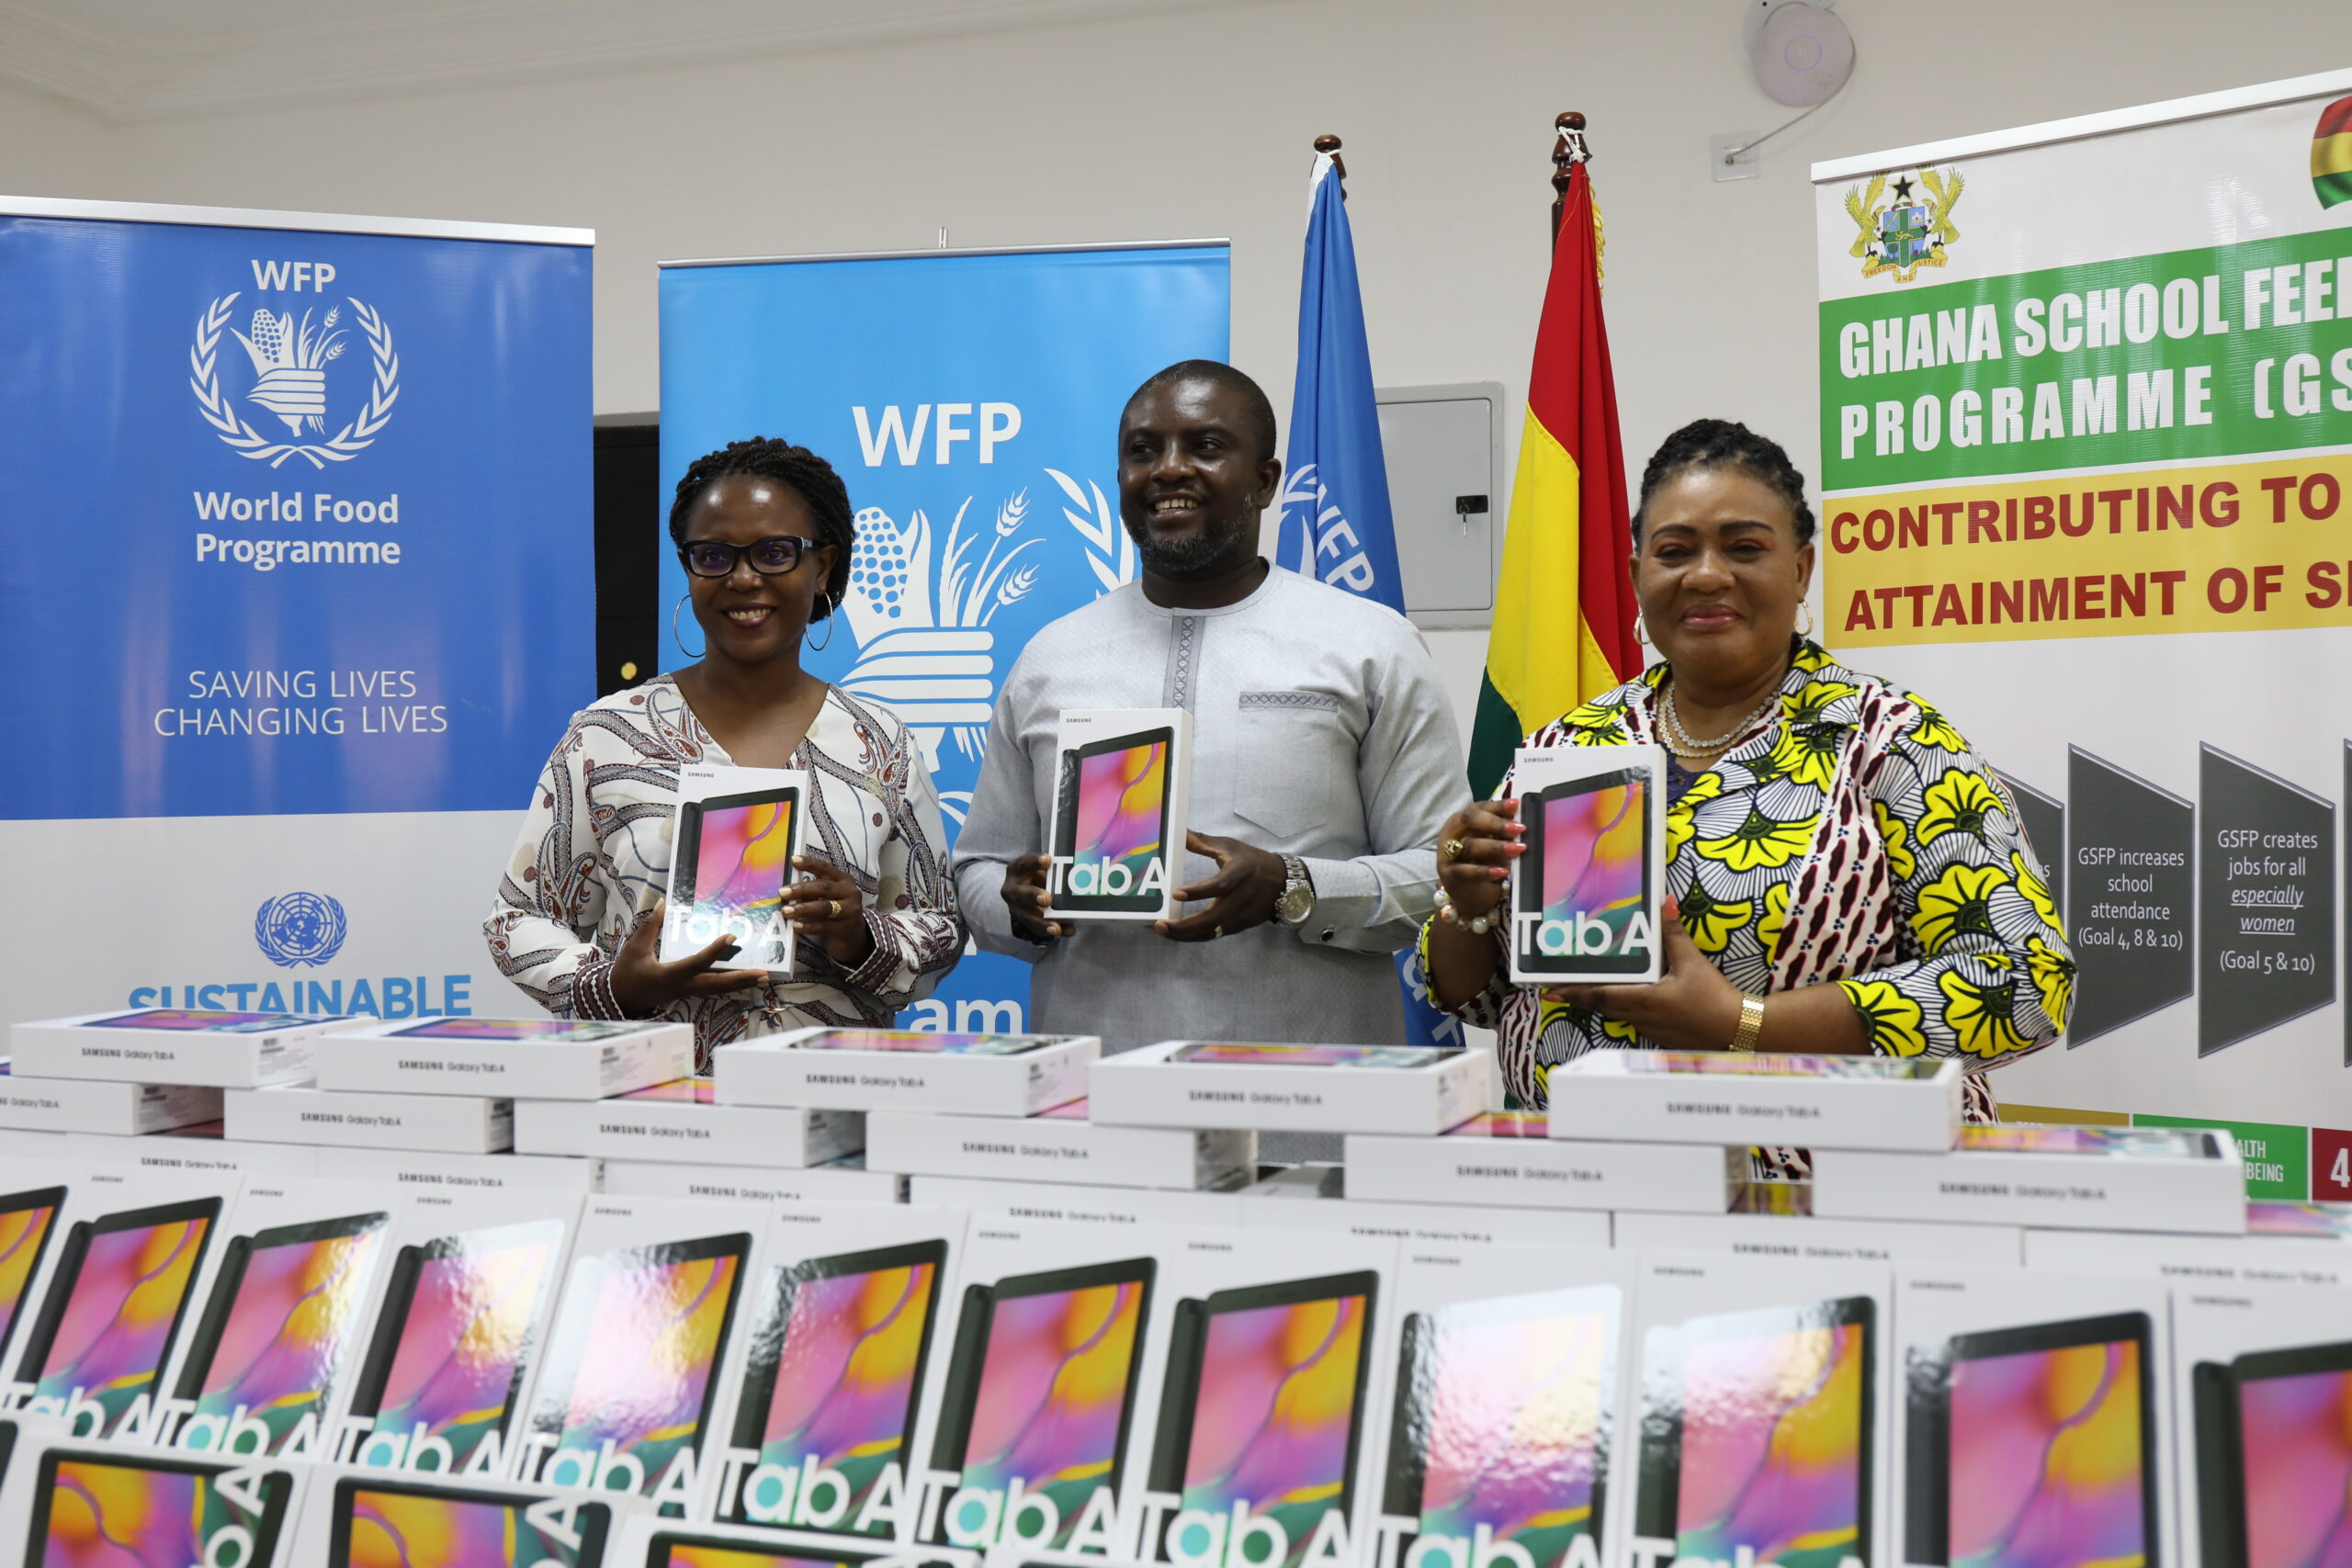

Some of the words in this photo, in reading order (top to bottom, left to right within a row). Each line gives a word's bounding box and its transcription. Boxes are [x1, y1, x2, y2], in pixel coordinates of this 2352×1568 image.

[252, 259, 336, 292] WFP
[1866, 265, 1896, 276] FREEDOM
[1839, 303, 2002, 378] GHANA
[2014, 275, 2228, 357] SCHOOL
[1841, 365, 2212, 459] PROGRAMME
[853, 402, 1022, 467] WFP
[194, 491, 302, 522] World
[314, 493, 399, 524] Food
[1830, 480, 2240, 554] CONTRIBUTING
[2261, 472, 2341, 524] TO
[196, 533, 401, 571] Programme
[1844, 570, 2186, 631] ATTAINMENT
[2207, 565, 2284, 614] OF
[2305, 560, 2352, 609] S
[188, 670, 317, 698] SAVING
[332, 671, 416, 698] LIVES
[153, 707, 345, 736] CHANGING
[363, 705, 447, 733] LIVES
[2218, 829, 2259, 849] GSFP
[2263, 831, 2318, 849] creates
[2078, 847, 2115, 866] GSFP
[2120, 847, 2185, 867] increases
[2227, 856, 2261, 880] jobs
[2264, 856, 2285, 875] for
[2290, 857, 2306, 876] all
[1053, 856, 1133, 896] Tab
[1138, 857, 1167, 896] A
[2108, 874, 2153, 893] school
[2090, 900, 2170, 920] attendance
[2232, 886, 2303, 908] especially
[1518, 910, 1612, 955] Tab
[1620, 911, 1653, 955] A
[2240, 917, 2295, 932] women
[2078, 927, 2114, 948] (Goal
[2118, 933, 2130, 950] 4,
[2134, 929, 2143, 946] 8
[2146, 929, 2157, 947] &
[2161, 931, 2183, 951] 10)
[2220, 950, 2260, 972] (Goal
[2264, 956, 2272, 975] 5
[2277, 953, 2288, 970] &
[2292, 954, 2315, 975] 10)
[129, 975, 471, 1020] SUSTAINABLE
[82, 1048, 121, 1057] SAMSUNG
[125, 1050, 153, 1061] Galaxy
[399, 1060, 444, 1070] SAMSUNG
[447, 1062, 480, 1074] Galaxy
[807, 1074, 855, 1085] SAMSUNG
[861, 1076, 897, 1089] Galaxy
[11, 1097, 38, 1108] Galaxy
[1189, 1090, 1244, 1102] SAMSUNG
[1250, 1093, 1290, 1106] Galaxy
[301, 1112, 344, 1122] SAMSUNG
[346, 1115, 378, 1126] Galaxy
[599, 1124, 646, 1134] SAMSUNG
[650, 1126, 685, 1139] Galaxy
[963, 1142, 1015, 1154] SAMSUNG
[1021, 1145, 1058, 1159] Galaxy
[1457, 1166, 1519, 1179] SAMSUNG
[1525, 1168, 1567, 1182] Galaxy
[2331, 1147, 2350, 1188] 4
[160, 1398, 270, 1456] Tab
[337, 1416, 453, 1472] Tab
[525, 1433, 644, 1493] Tab
[719, 1447, 851, 1528] Tab
[920, 1471, 1059, 1549] Tab
[1139, 1491, 1288, 1568] Tab
